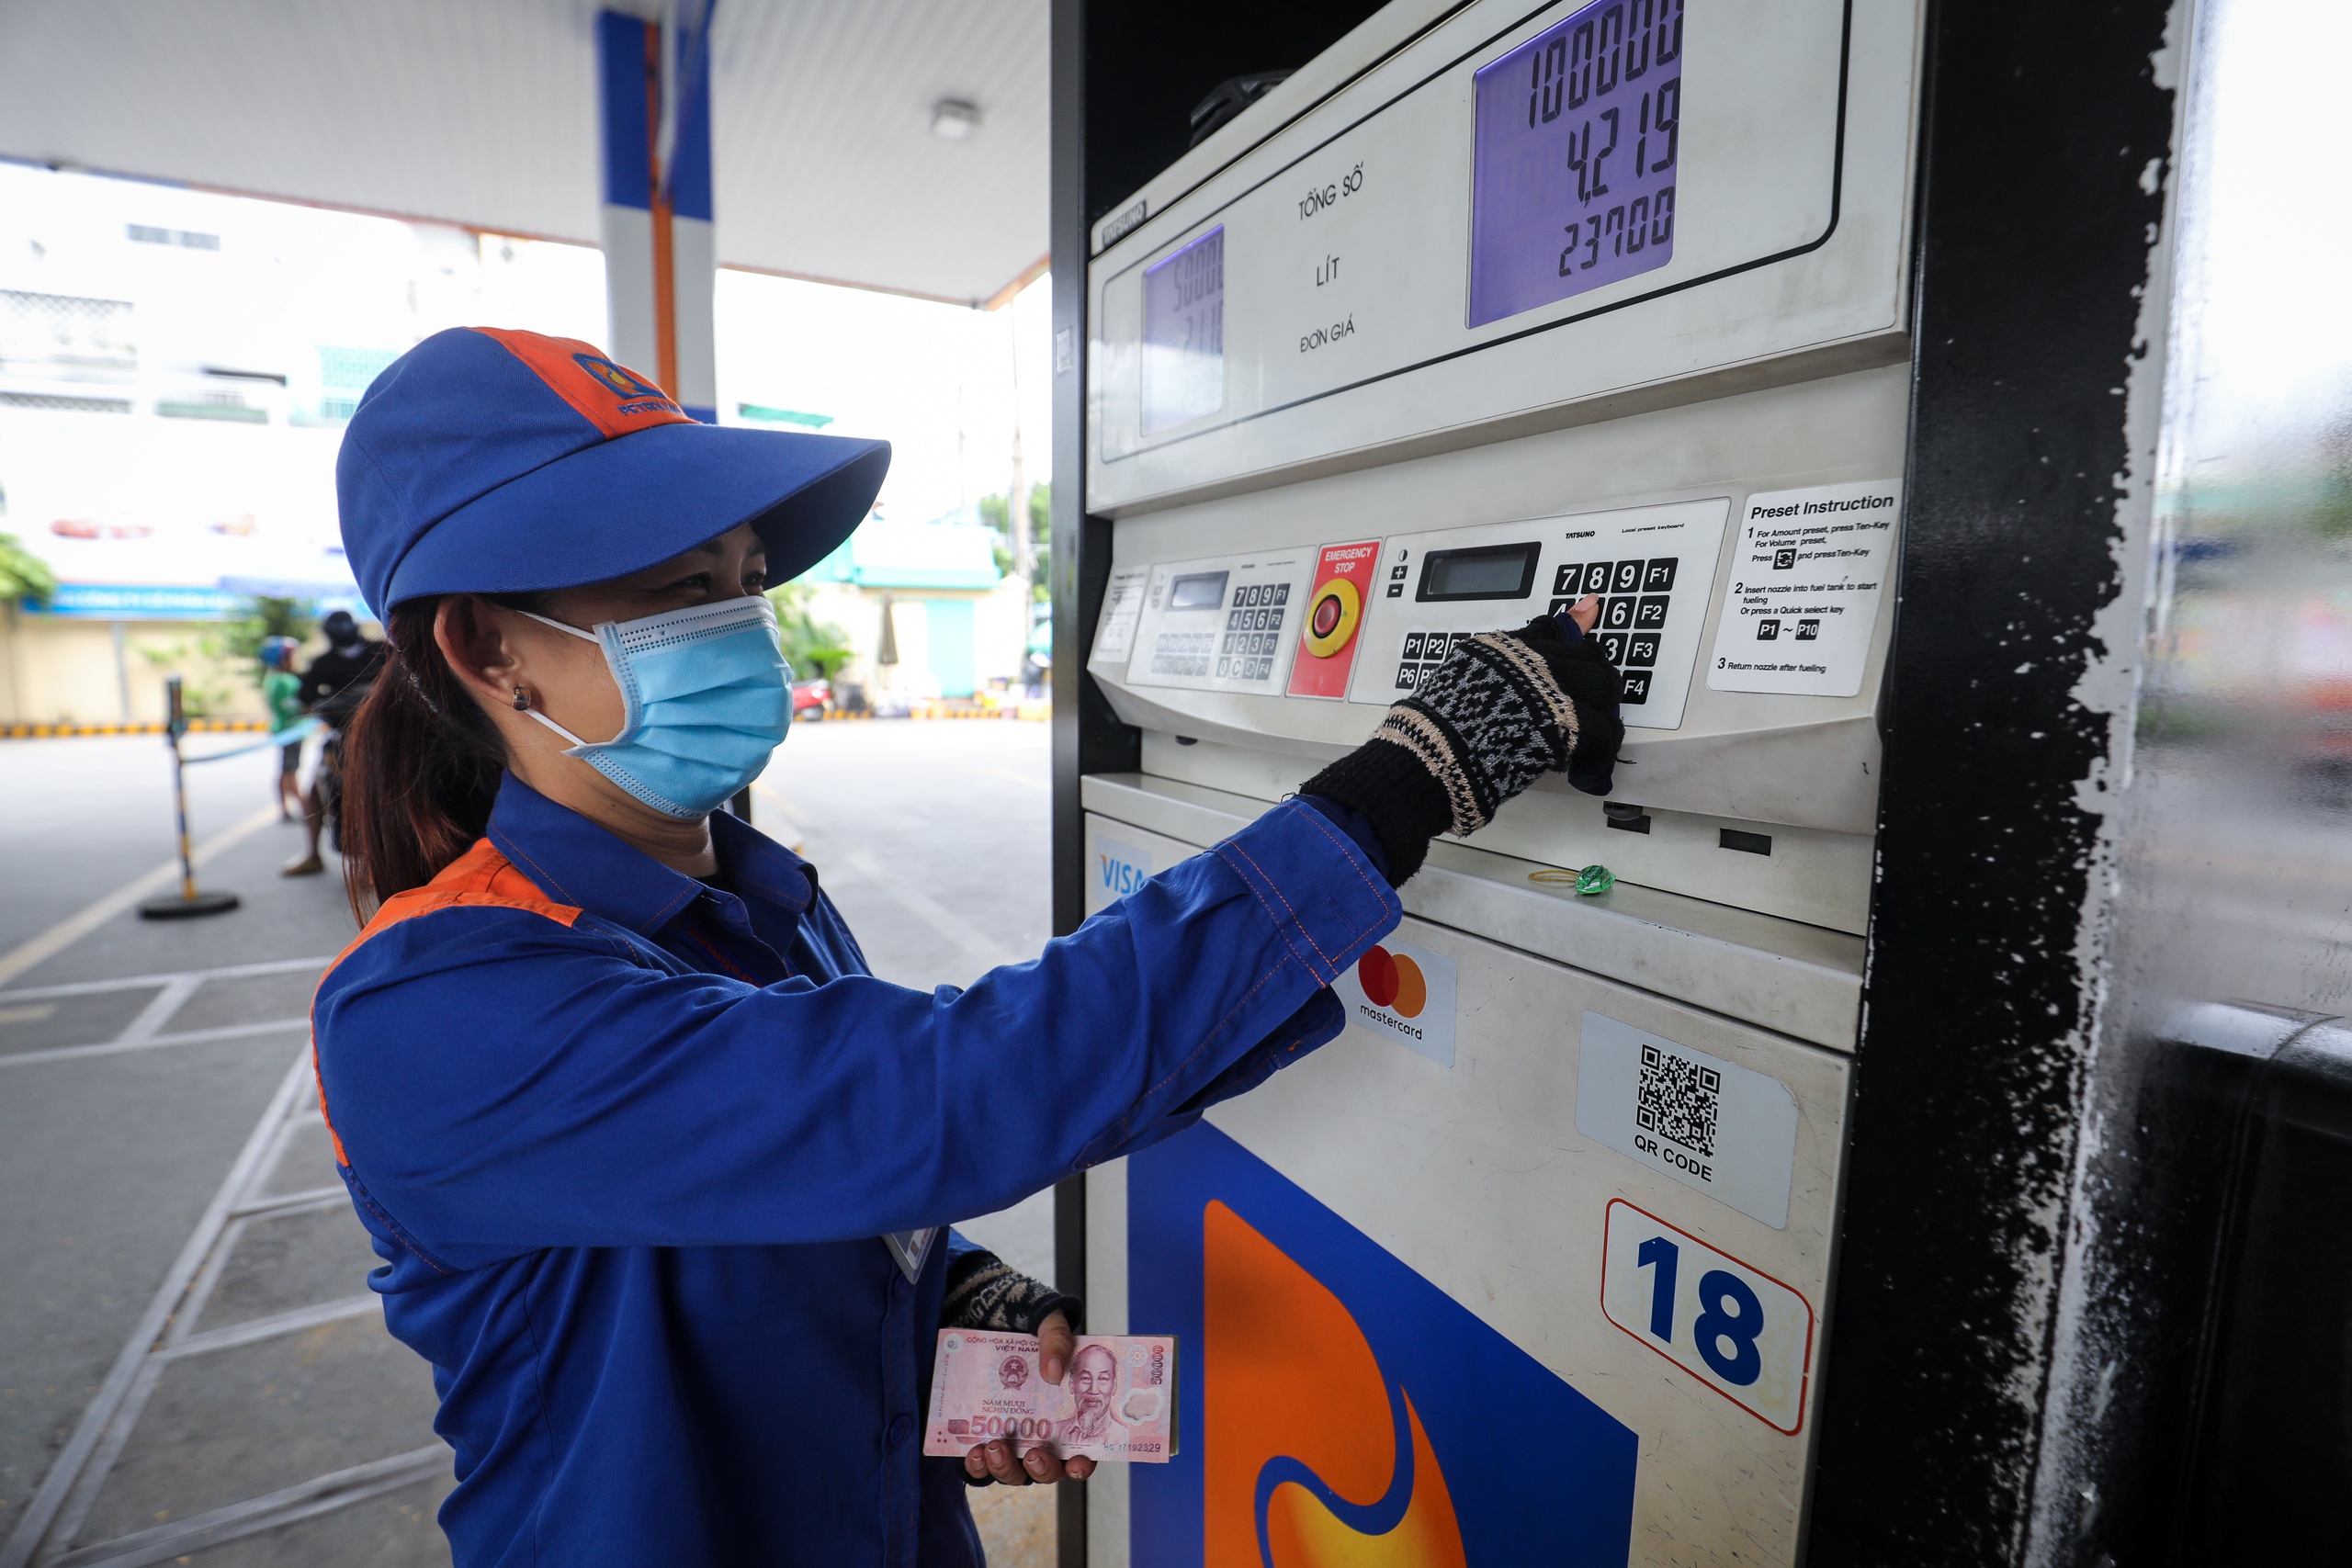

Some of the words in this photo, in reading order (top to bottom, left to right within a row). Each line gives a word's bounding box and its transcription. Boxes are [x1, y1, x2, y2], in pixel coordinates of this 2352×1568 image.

[1529, 0, 1683, 130] 100000
[1298, 184, 1337, 221] TỔNG
[1342, 160, 1364, 197] SỐ
[1559, 186, 1675, 277] 23700
[1317, 254, 1340, 287] LÍT
[1300, 328, 1328, 353] ĐƠN
[1330, 312, 1355, 342] GIÁ
[1750, 503, 1800, 520] Preset
[1803, 495, 1894, 514] Instruction
[1566, 530, 1595, 539] TATSUNO
[1747, 526, 1754, 538] 1
[1757, 530, 1770, 538] For
[1771, 528, 1801, 536] Amount
[1802, 526, 1829, 537] preset,
[1831, 525, 1854, 535] press
[1856, 521, 1891, 531] Ten-Key
[1755, 540, 1768, 548] For
[1770, 539, 1796, 547] Volume
[1800, 536, 1827, 547] preset,
[1325, 547, 1373, 561] EMERGENCY
[1334, 561, 1355, 573] STOP
[1561, 569, 1577, 591] 7
[1589, 567, 1605, 590] 8
[1620, 565, 1635, 589] 9
[1649, 567, 1669, 583] F1
[1735, 582, 1743, 593] 2
[1793, 584, 1808, 592] into
[1236, 589, 1245, 605] 7
[1249, 588, 1258, 604] 8
[1262, 587, 1272, 604] 9
[1275, 589, 1286, 601] F1
[1743, 596, 1768, 605] fueling
[1611, 602, 1627, 626] 6
[1640, 604, 1662, 621] F2
[1750, 608, 1772, 616] press
[1780, 606, 1803, 615] Quick
[1804, 605, 1828, 614] select
[1829, 605, 1845, 615] key
[1231, 612, 1238, 627] 4
[1243, 612, 1252, 628] 5
[1257, 612, 1266, 628] 6
[1270, 614, 1281, 625] F2
[1759, 625, 1776, 636] P1
[1796, 625, 1818, 636] P10
[1226, 637, 1232, 652] 1
[1237, 637, 1246, 652] 2
[1250, 637, 1260, 652] 3
[1264, 638, 1275, 650] F3
[1405, 638, 1421, 654] P1
[1426, 638, 1443, 654] P2
[1632, 642, 1654, 659] F3
[1231, 660, 1241, 676] C
[1717, 657, 1725, 670] 3
[1728, 662, 1752, 671] Return
[1799, 664, 1826, 673] fueling
[1398, 669, 1416, 684] P6
[1623, 679, 1644, 695] F4
[1100, 852, 1143, 894] VISA
[1360, 1004, 1423, 1041] mastercard
[1634, 1134, 1659, 1157] QR
[1663, 1148, 1713, 1182] CODE
[1637, 1236, 1764, 1386] 18
[1118, 1443, 1161, 1453] 17192329
